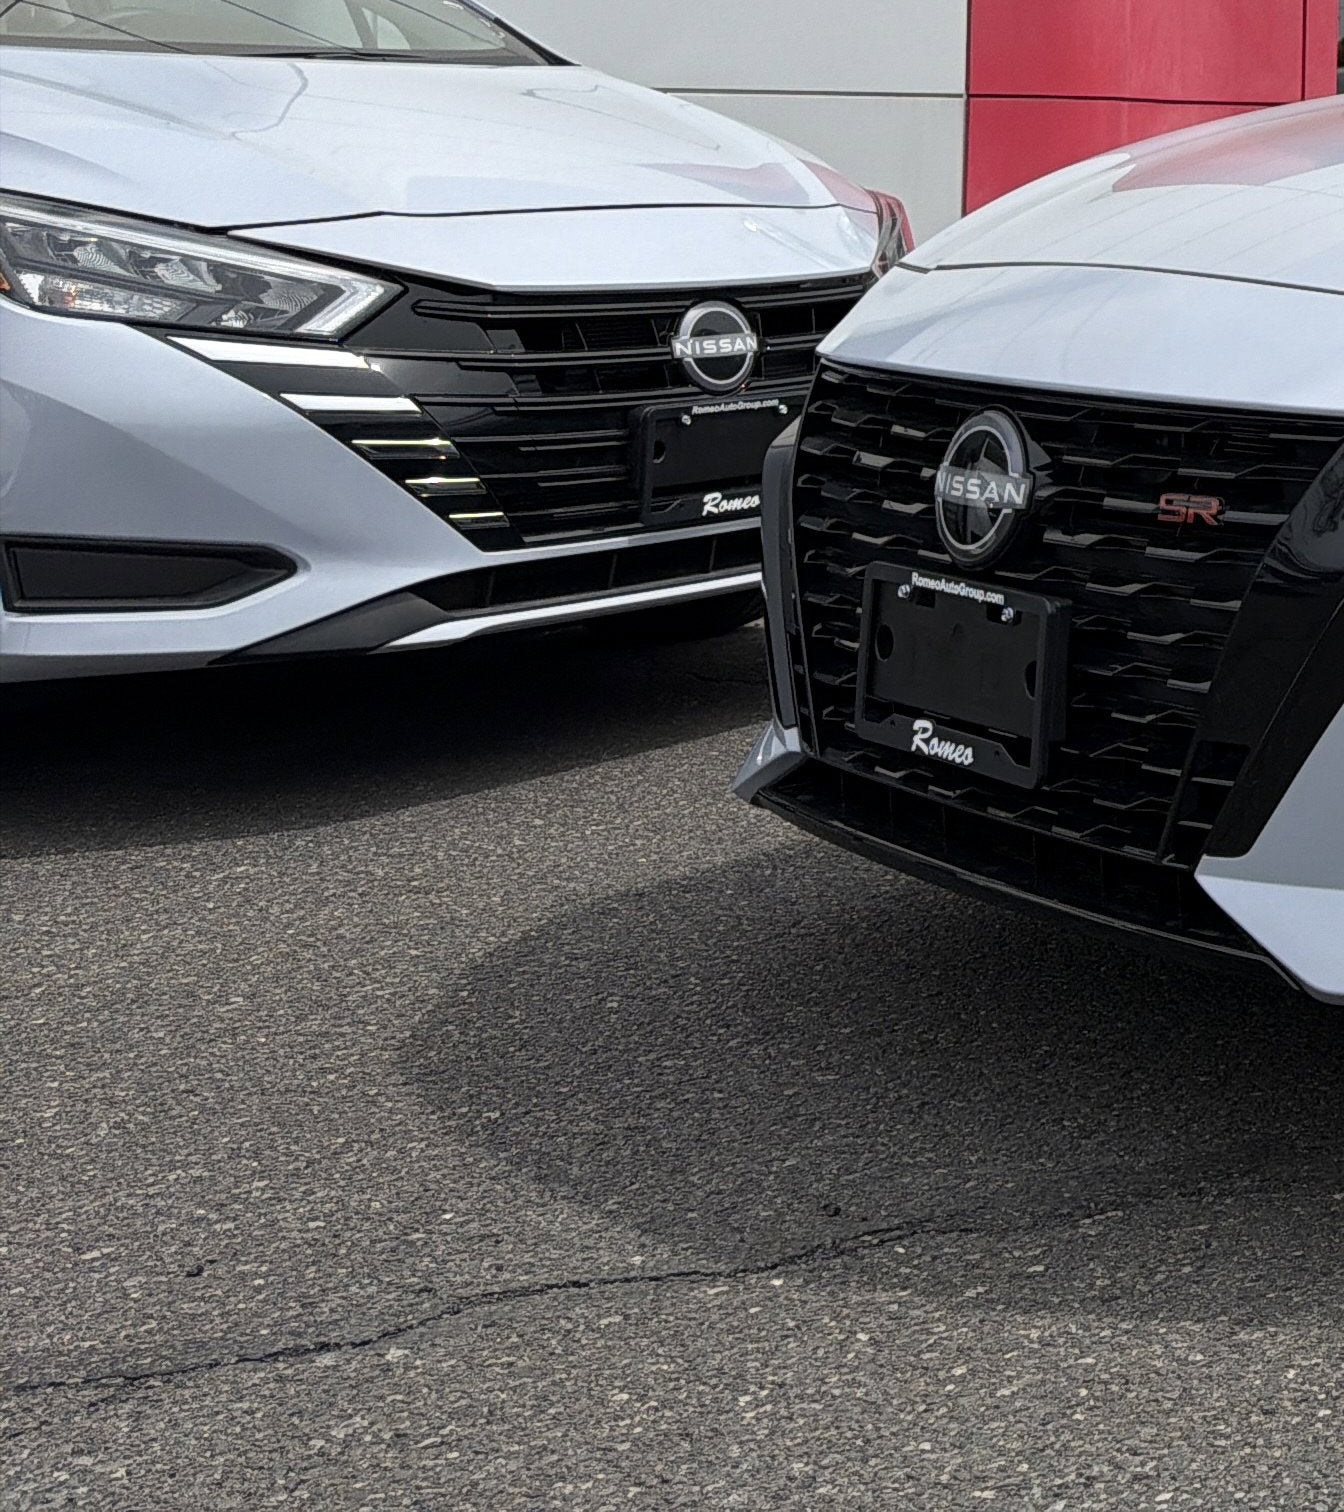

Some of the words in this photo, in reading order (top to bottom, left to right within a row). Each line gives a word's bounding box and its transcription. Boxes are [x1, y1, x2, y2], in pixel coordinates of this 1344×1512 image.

[674, 336, 758, 357] NISSAN
[692, 399, 779, 415] RomeoAutoGroup.com
[702, 491, 760, 516] Romeo
[935, 470, 1026, 505] NISSAN
[1157, 492, 1220, 526] SR
[911, 572, 1005, 606] RomeoAutoGroup.com
[910, 719, 974, 766] Romeo
